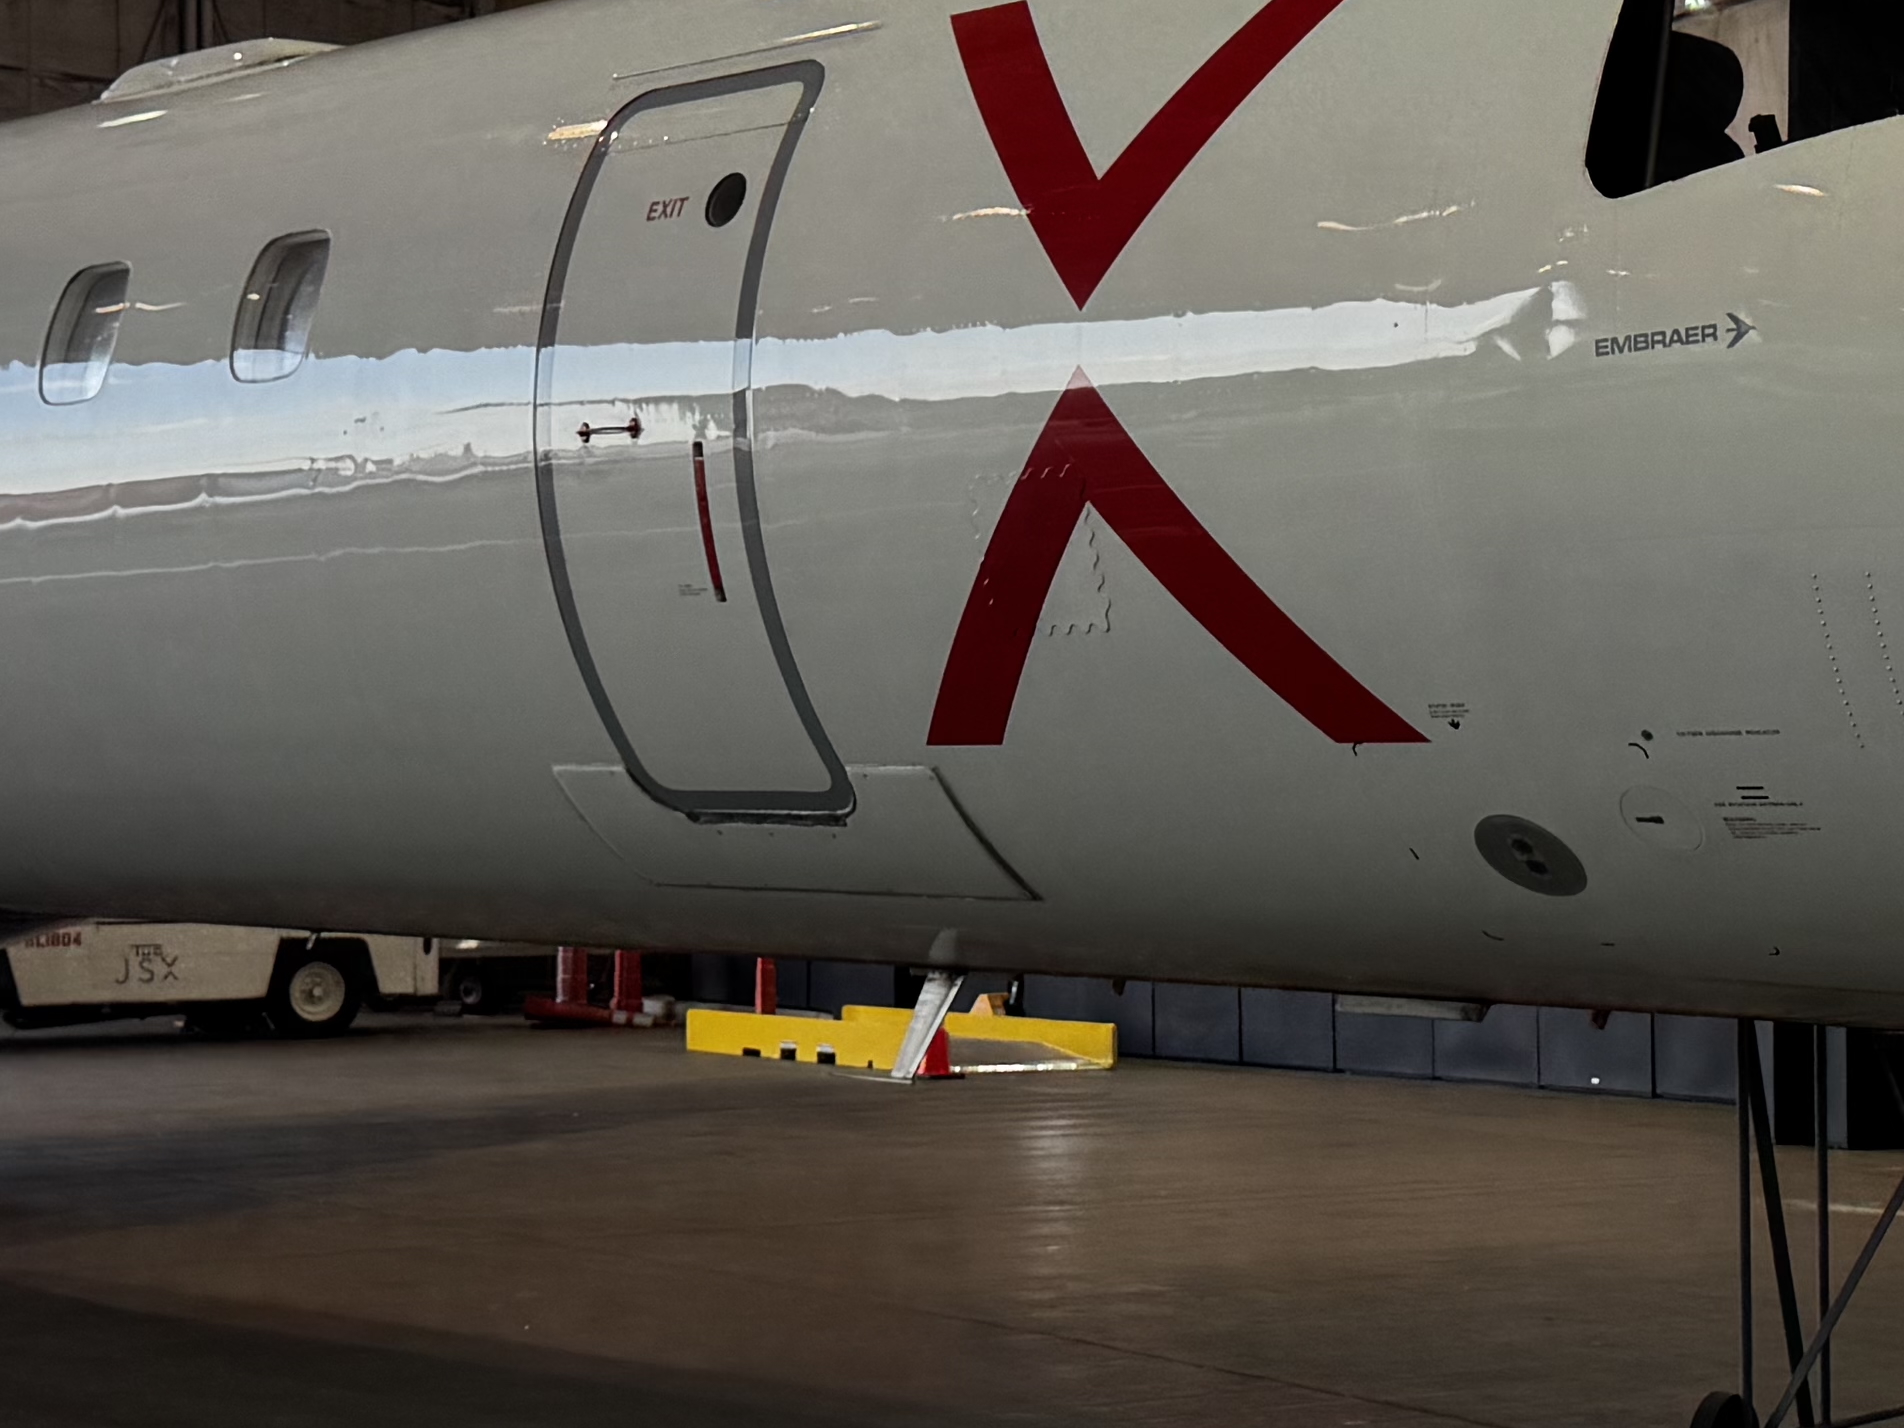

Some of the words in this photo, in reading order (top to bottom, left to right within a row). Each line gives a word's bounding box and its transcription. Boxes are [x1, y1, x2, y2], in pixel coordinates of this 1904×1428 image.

[646, 195, 690, 222] EXIT
[1595, 323, 1718, 357] EMBRAER
[115, 955, 179, 985] JSX
